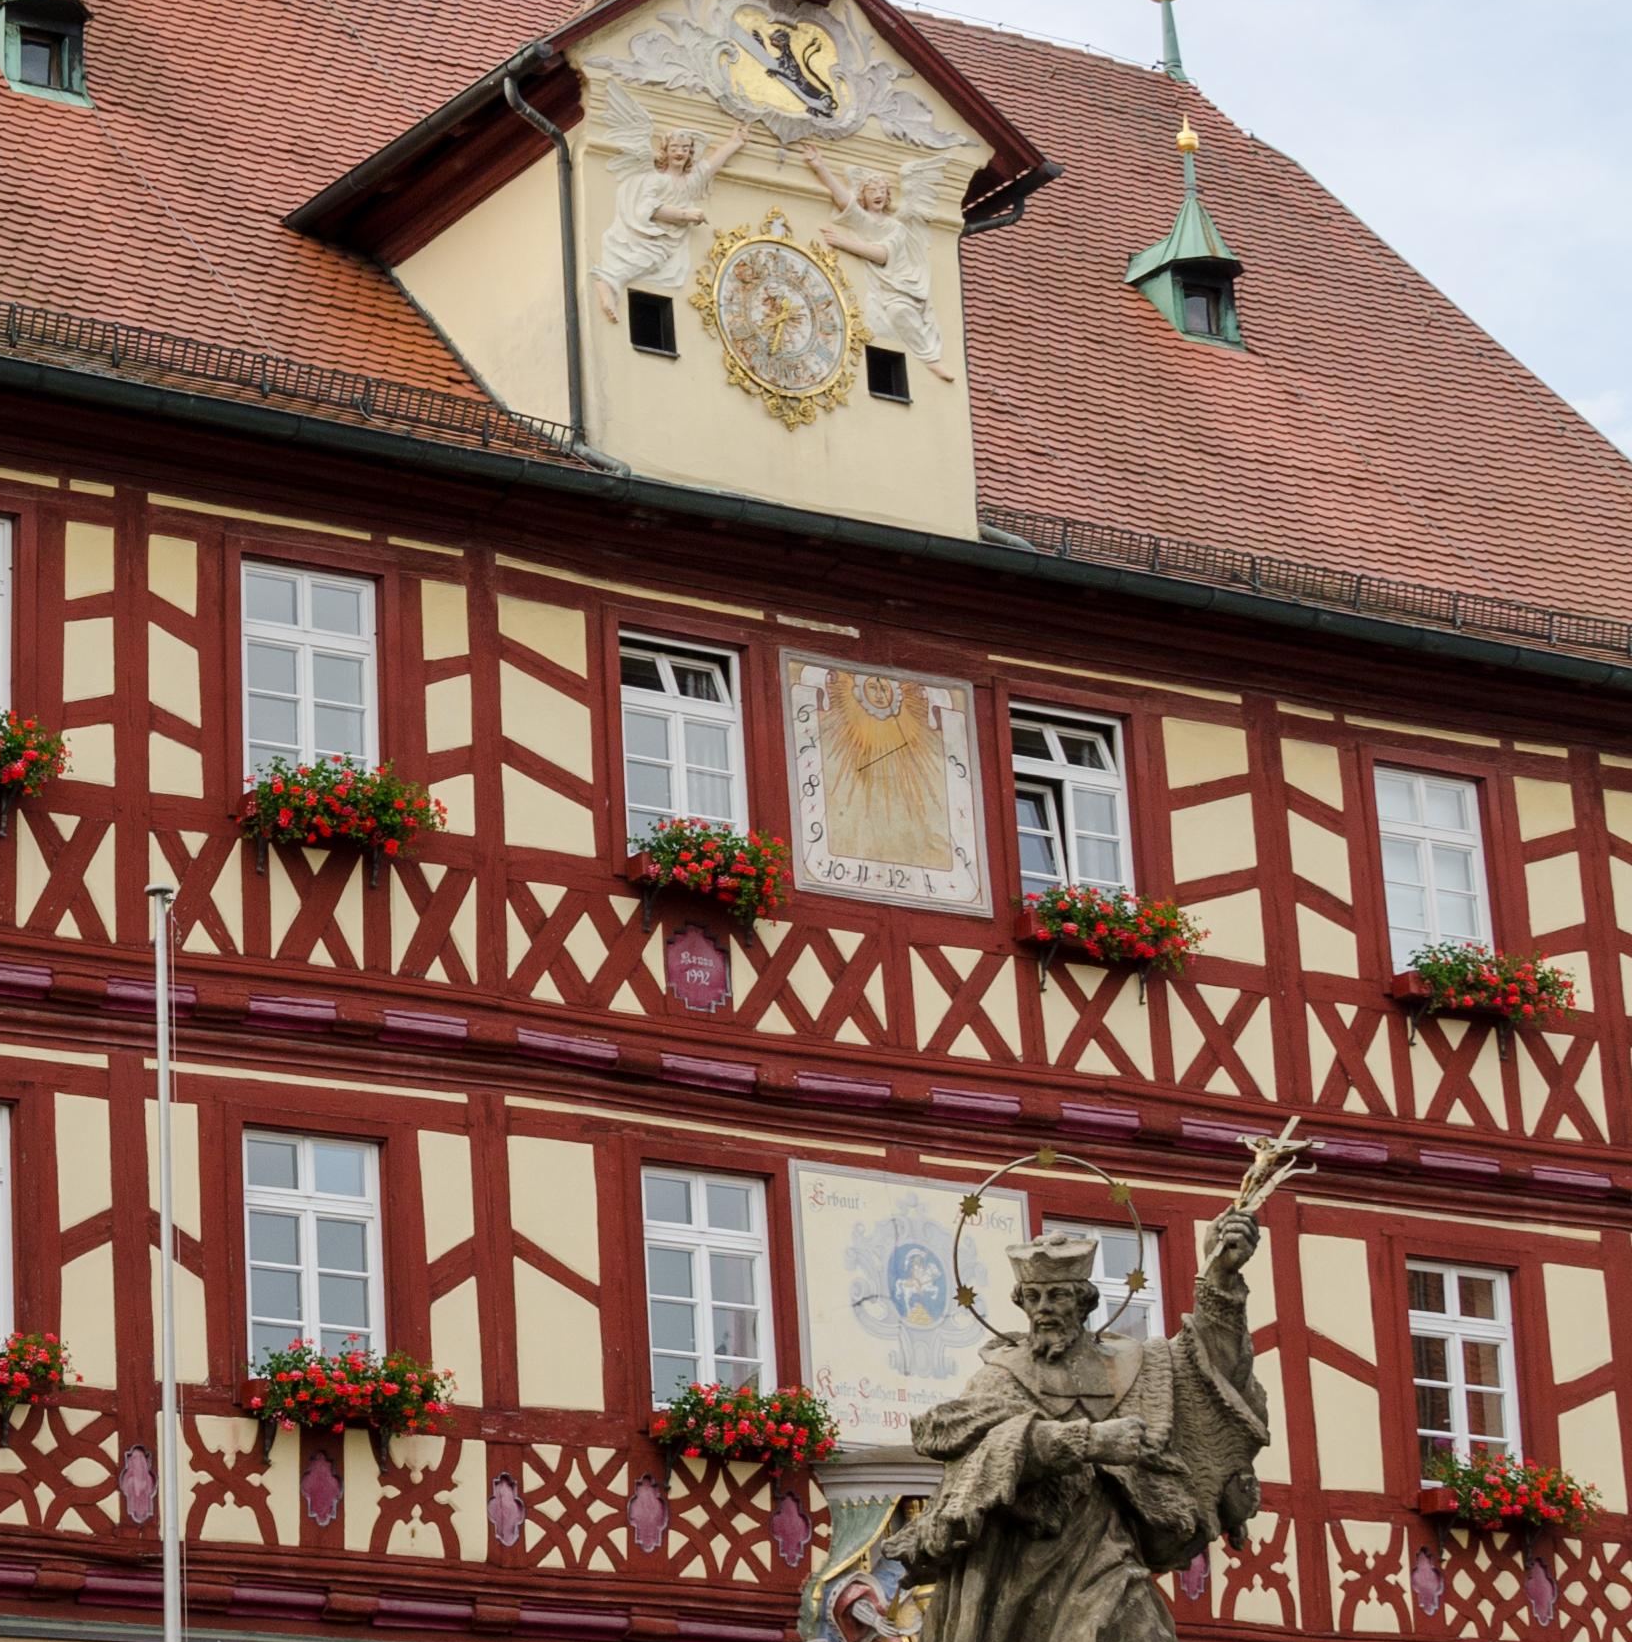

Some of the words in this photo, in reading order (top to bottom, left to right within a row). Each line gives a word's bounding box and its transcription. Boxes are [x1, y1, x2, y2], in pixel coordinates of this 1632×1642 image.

[948, 755, 967, 778] 3
[803, 774, 820, 797] 8
[822, 859, 846, 881] 10
[885, 868, 907, 889] 12
